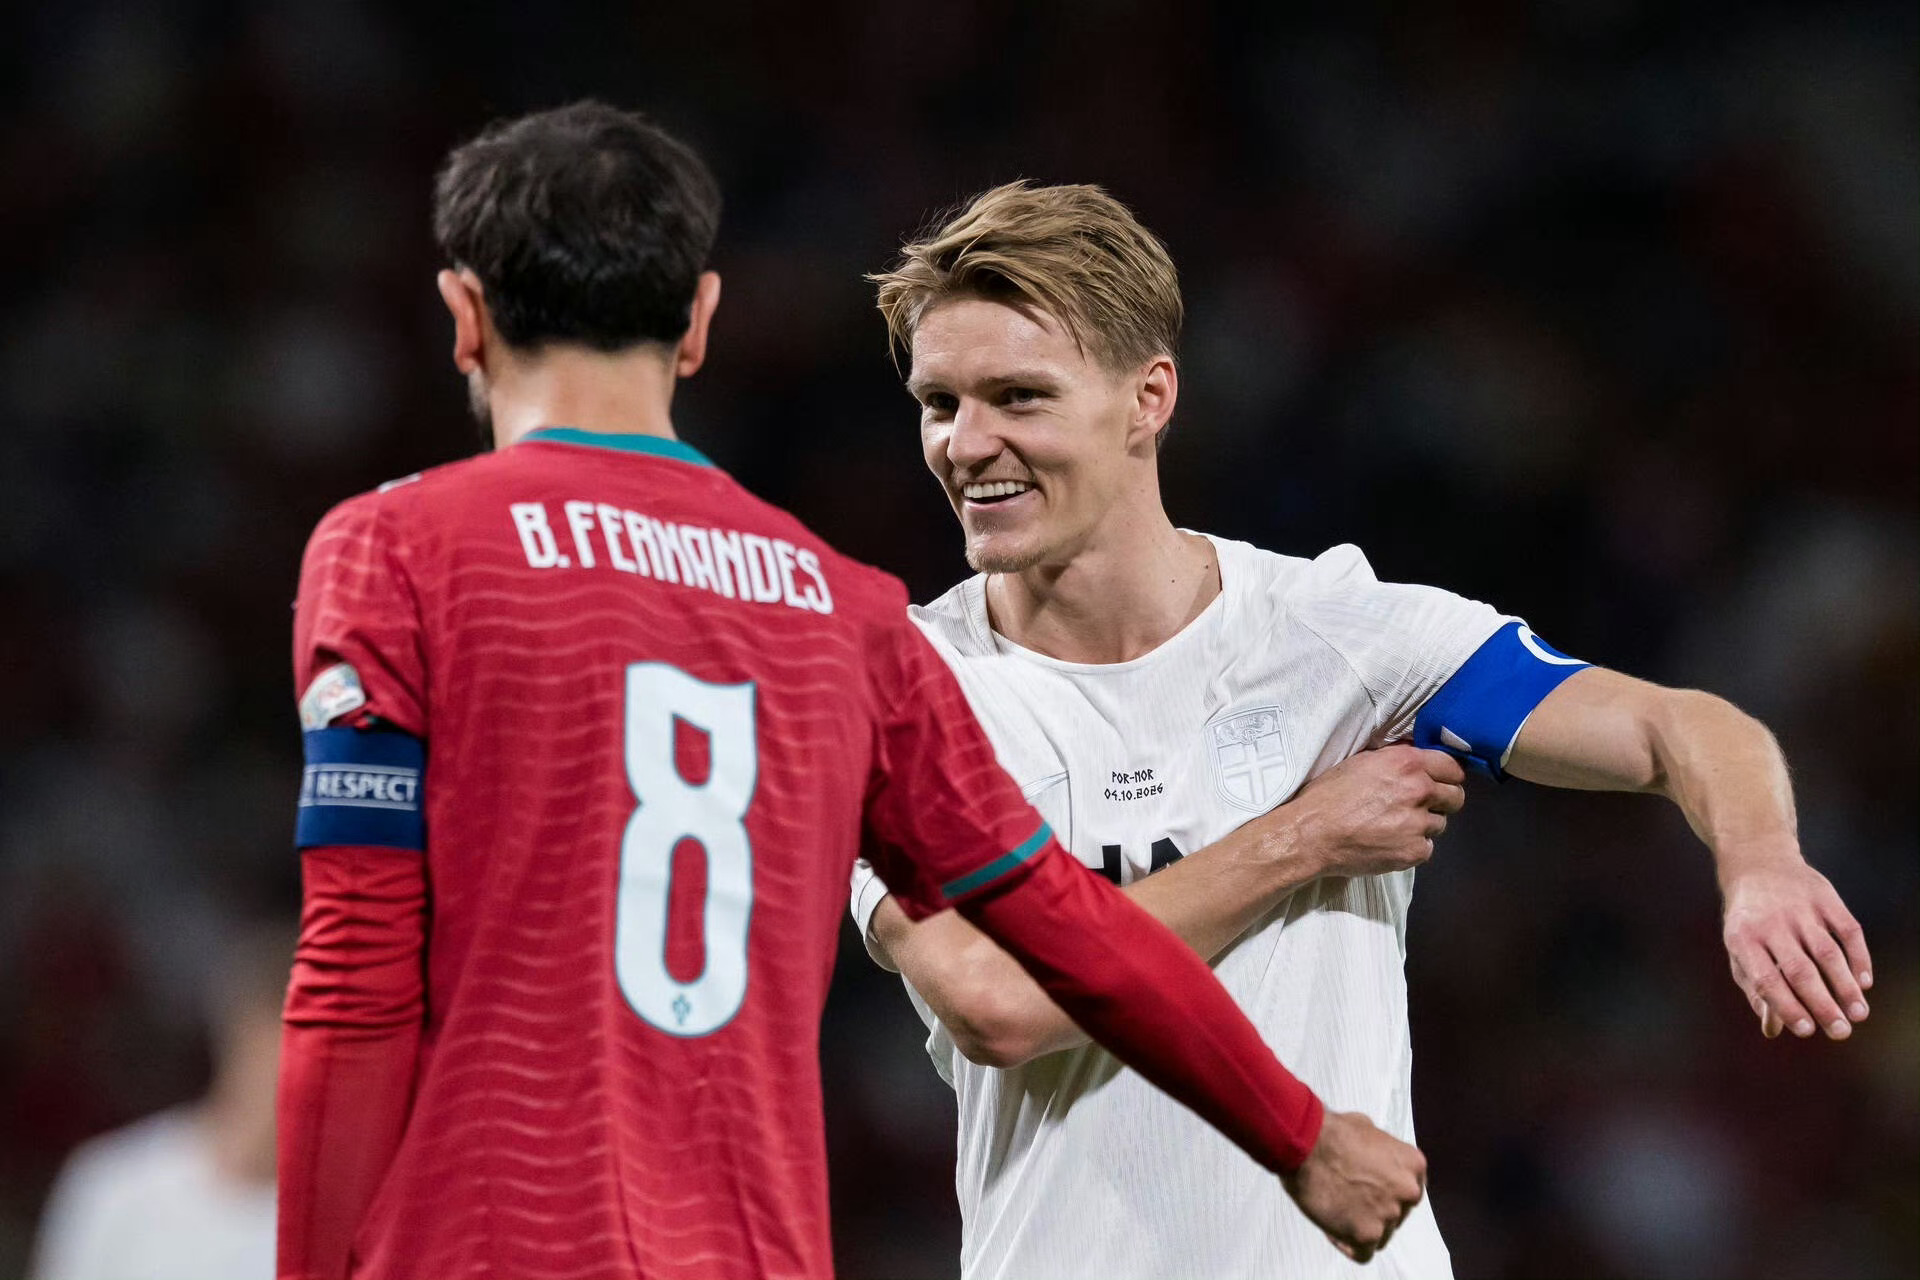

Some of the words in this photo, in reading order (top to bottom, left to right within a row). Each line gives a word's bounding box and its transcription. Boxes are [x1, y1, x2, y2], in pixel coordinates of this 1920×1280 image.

[316, 772, 417, 801] RESPECT
[1111, 768, 1154, 784] POR-NOR
[1104, 783, 1163, 801] 04.10.2026
[614, 660, 759, 1038] 8
